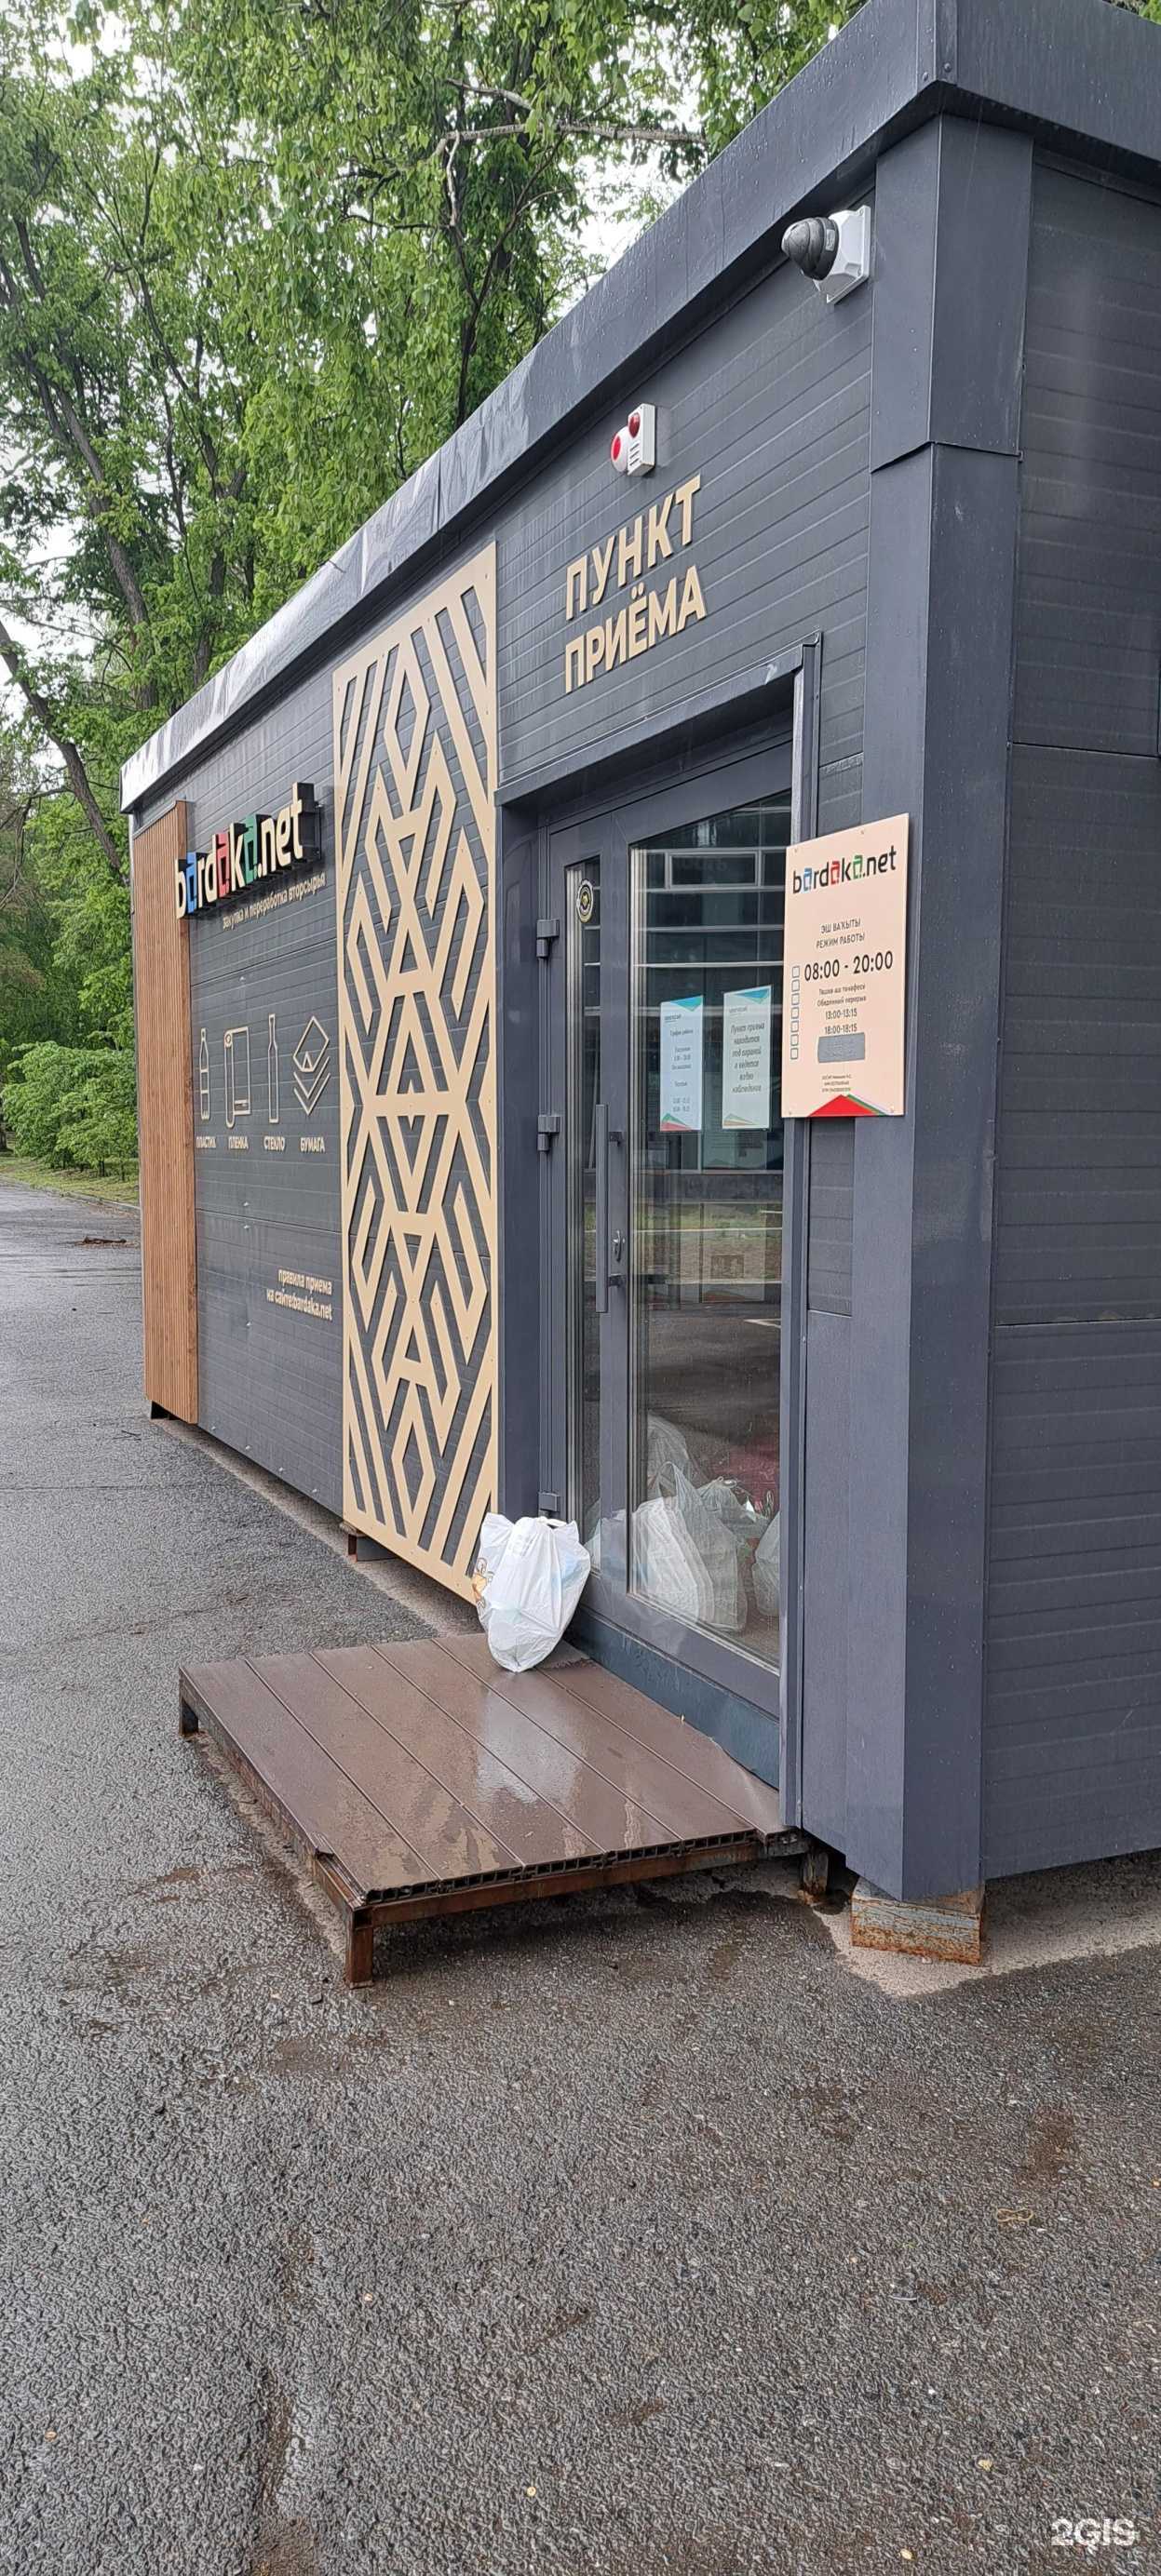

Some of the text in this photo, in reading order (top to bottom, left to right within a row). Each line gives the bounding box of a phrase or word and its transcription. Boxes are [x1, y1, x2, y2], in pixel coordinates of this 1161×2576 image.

[566, 474, 701, 622] ПУНКТ
[565, 565, 708, 695] ПРИЁМА
[175, 782, 305, 920] bardaka.net
[792, 845, 897, 893] bardaka.net
[250, 891, 288, 919] переработка
[289, 872, 326, 902] вторсырья
[816, 932, 865, 949] РЕЖИМ РАБОТЫ
[804, 963, 840, 982] 08:00
[853, 950, 894, 974] 20:00
[825, 1007, 857, 1021] 13:00-13:15
[263, 1136, 286, 1152] СТЕКЛО
[300, 1136, 326, 1153] БУМАГА
[278, 1268, 305, 1288] правила
[266, 1288, 275, 1302] на
